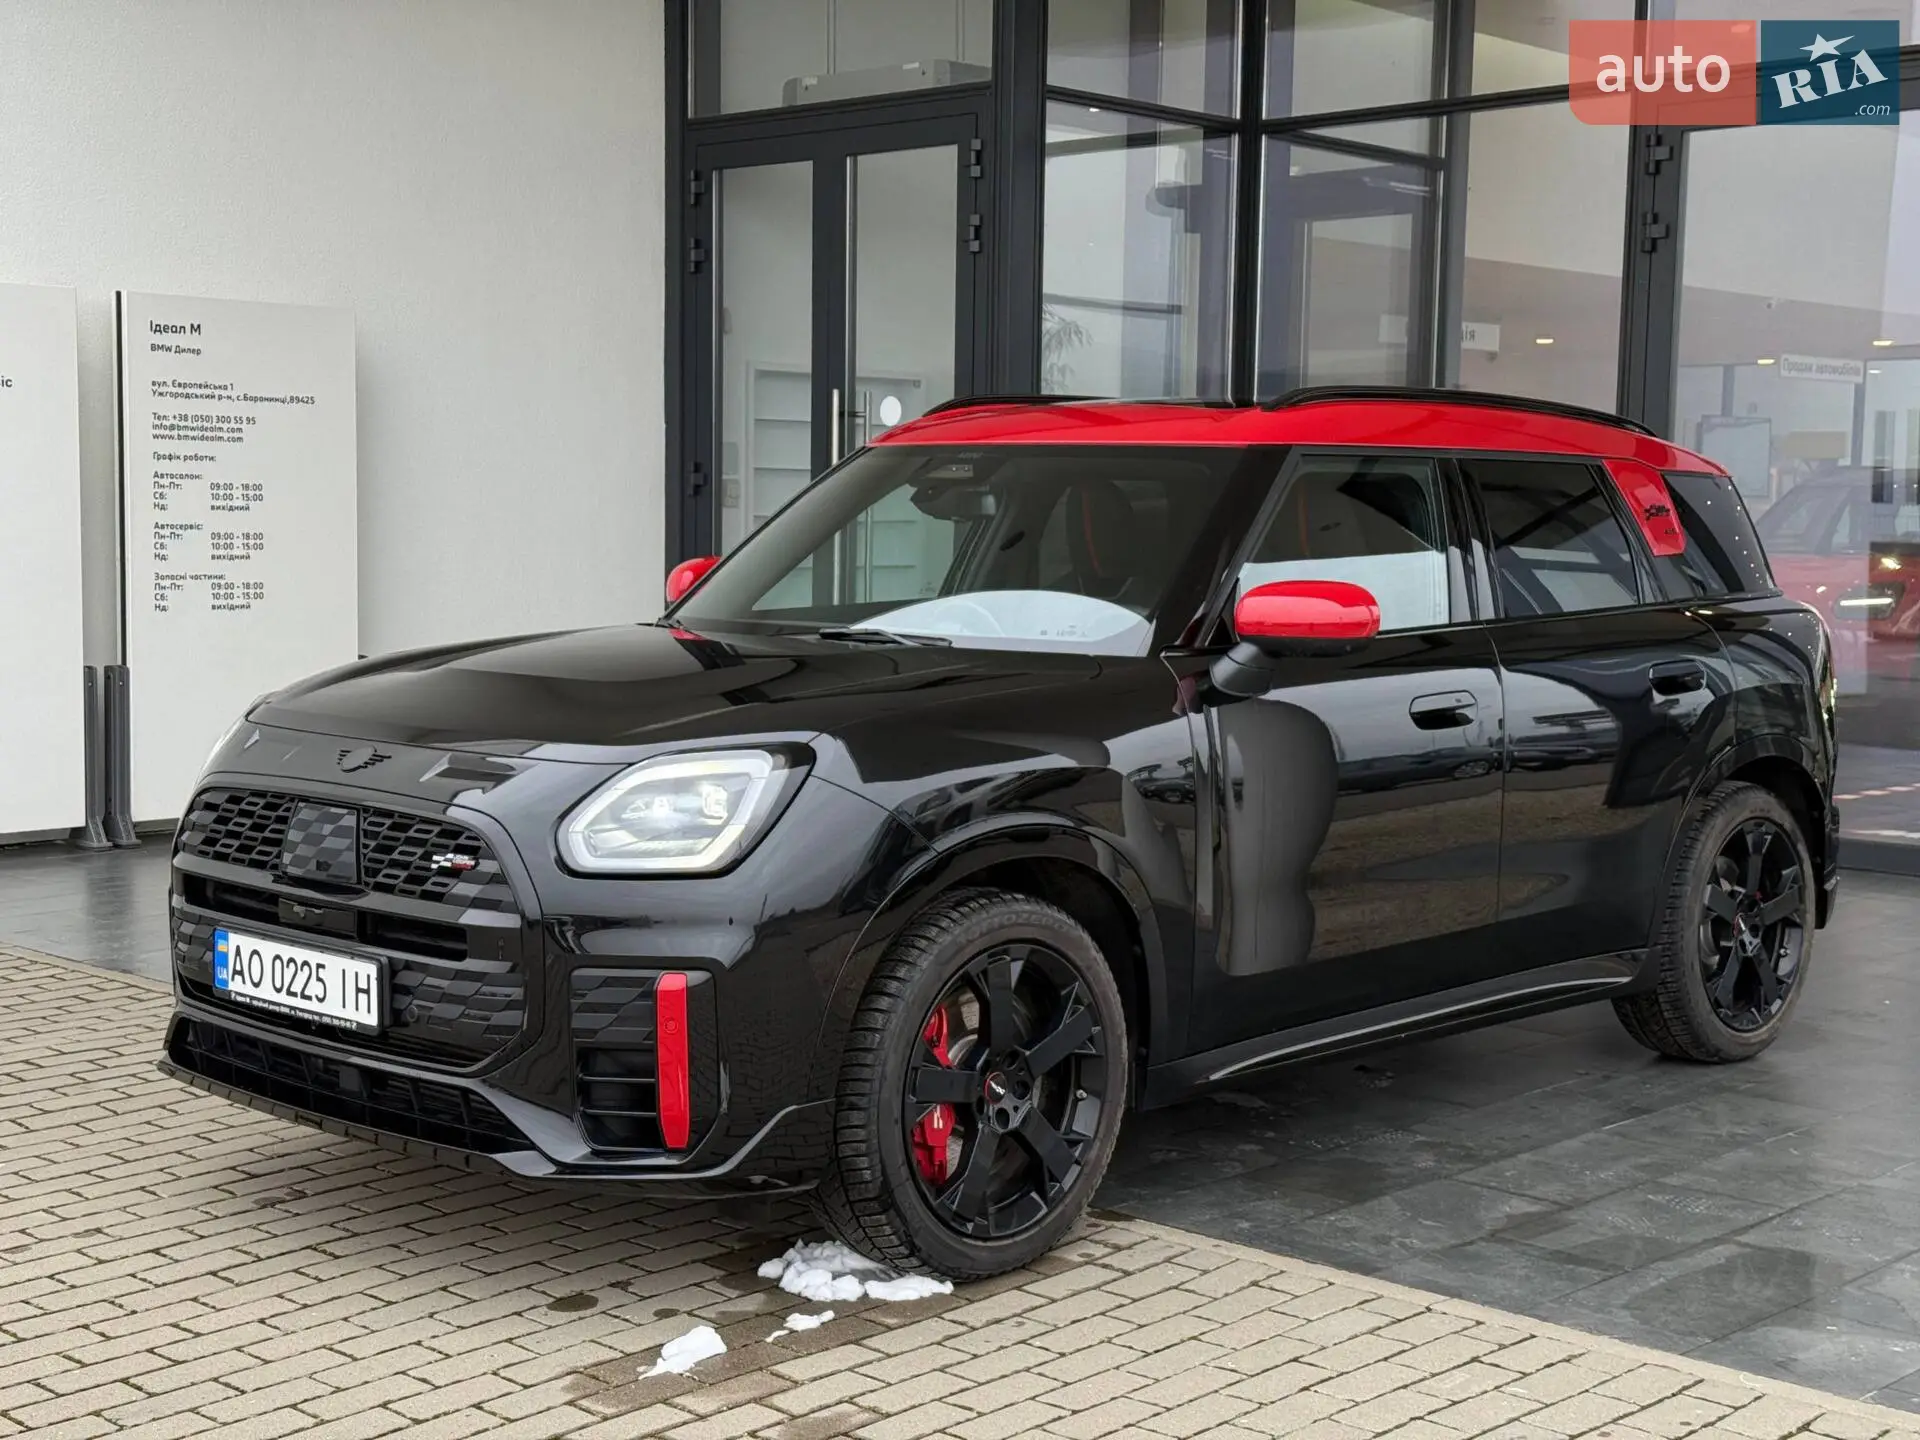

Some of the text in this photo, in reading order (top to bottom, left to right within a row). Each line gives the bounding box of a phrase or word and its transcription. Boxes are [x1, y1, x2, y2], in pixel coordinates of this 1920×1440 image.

[150, 320, 186, 335] Ідеал
[150, 343, 202, 356] BMW Дилер
[152, 379, 234, 391] вул. Європейська 1
[152, 389, 216, 401] Ужгородський
[218, 394, 235, 402] р-н,
[152, 412, 256, 425] Тел: +38 (050) 300 55 95
[152, 423, 243, 434] info@bmwidealm.com
[152, 433, 244, 443] www.bmwidealm.com
[152, 451, 216, 462] Графік роботи:
[153, 470, 203, 480] Автосалон:
[153, 481, 183, 490] Пн-Пт:
[210, 482, 234, 491] 09:00
[241, 483, 263, 491] 18:00
[153, 491, 168, 500] Сб:
[210, 492, 234, 501] 10:00
[241, 493, 264, 502] 15:00
[153, 501, 250, 512] Нд: вихідний
[153, 521, 203, 531] Автосервіс:
[153, 531, 183, 540] Пн-Пт:
[211, 532, 234, 541] 09:00
[241, 532, 264, 541] 18:00
[153, 541, 168, 550] Сб:
[211, 542, 234, 551] 10:00
[241, 542, 264, 551] 15:00
[154, 552, 251, 562] Нд: вихідний
[154, 572, 226, 581] Запасні частини:
[154, 582, 184, 591] Пн-Пт:
[211, 582, 235, 590] 09:00
[241, 582, 264, 590] 18:00
[154, 592, 168, 601] Сб:
[211, 592, 235, 601] 10:00
[242, 591, 264, 600] 15:00
[154, 602, 251, 612] Нд: вихідний
[218, 967, 228, 979] UA
[231, 945, 264, 988] AO
[272, 954, 326, 1003] 0225
[341, 968, 371, 1014] IH
